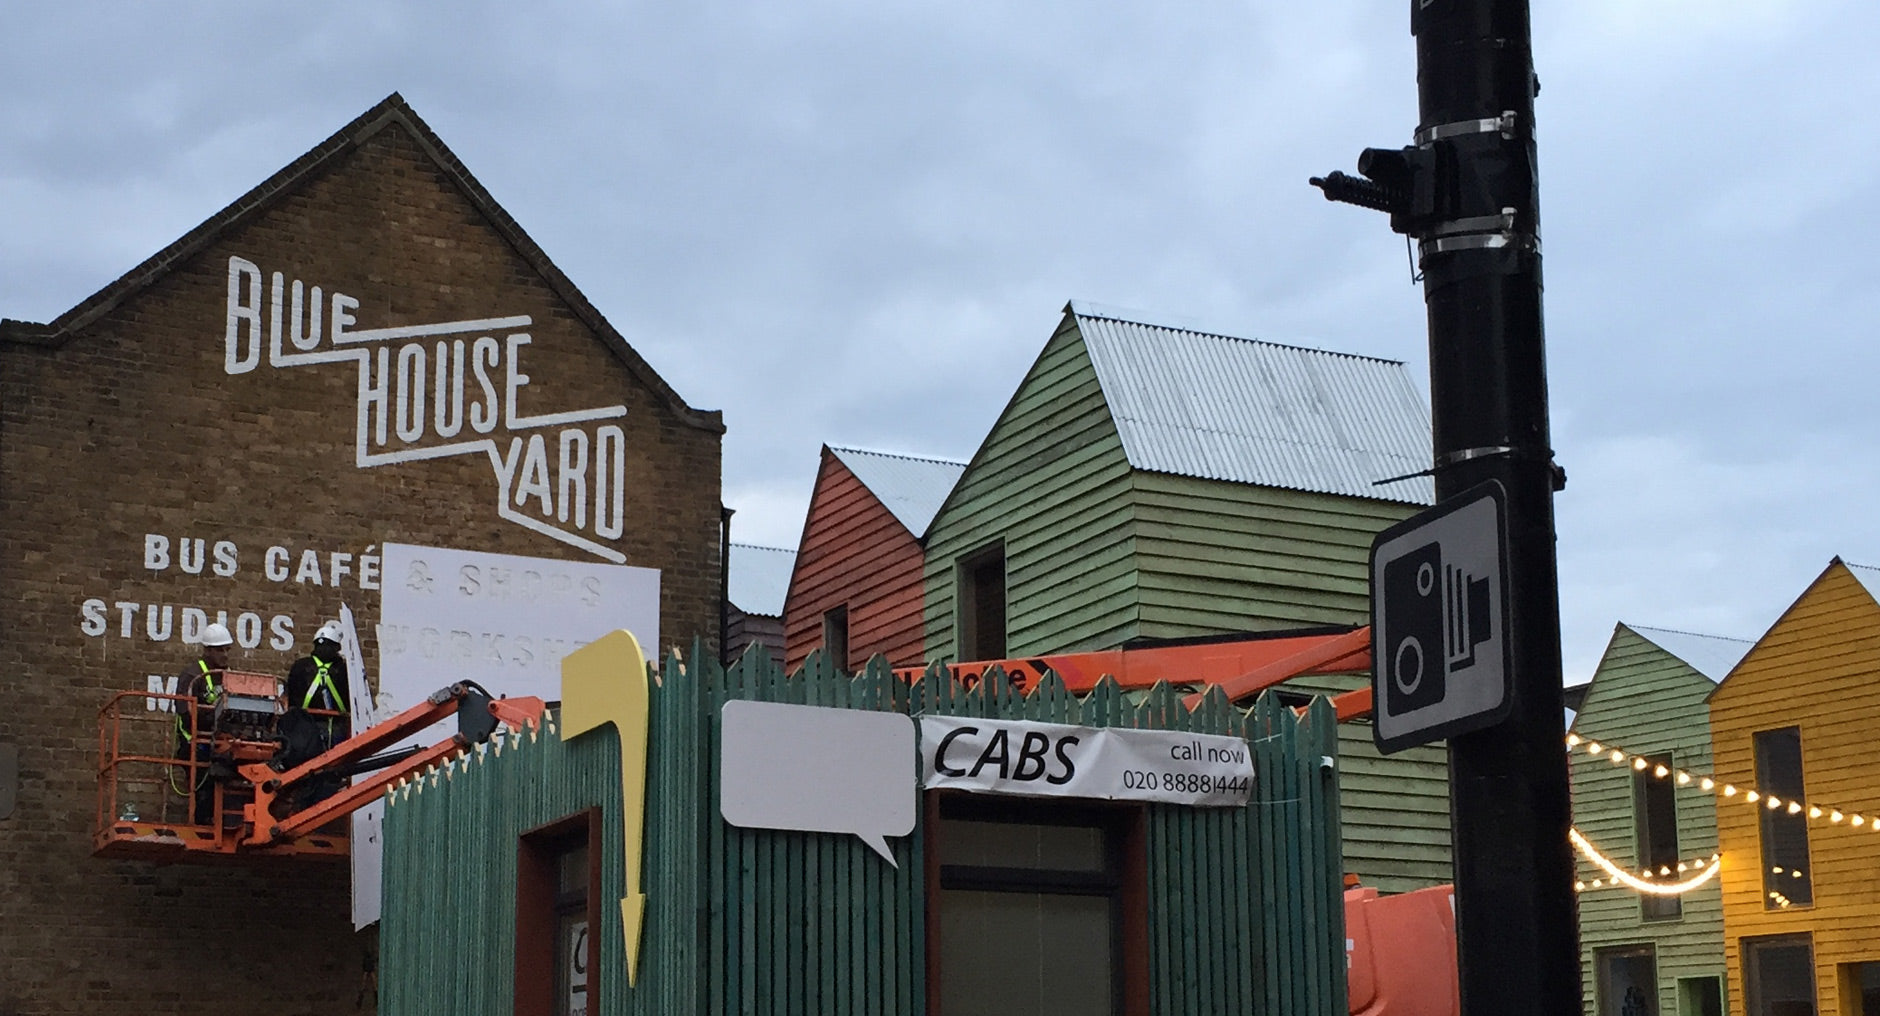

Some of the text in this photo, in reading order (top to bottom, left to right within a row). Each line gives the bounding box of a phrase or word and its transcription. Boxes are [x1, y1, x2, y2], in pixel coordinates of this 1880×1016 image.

[225, 256, 385, 374] BLUE
[357, 333, 535, 468] HOUSE
[488, 426, 627, 563] YARD
[144, 534, 238, 577] BUS
[265, 544, 380, 590] CAFÉ
[934, 727, 1079, 785] CABS
[1123, 770, 1158, 791] 020
[1171, 741, 1244, 764] call now
